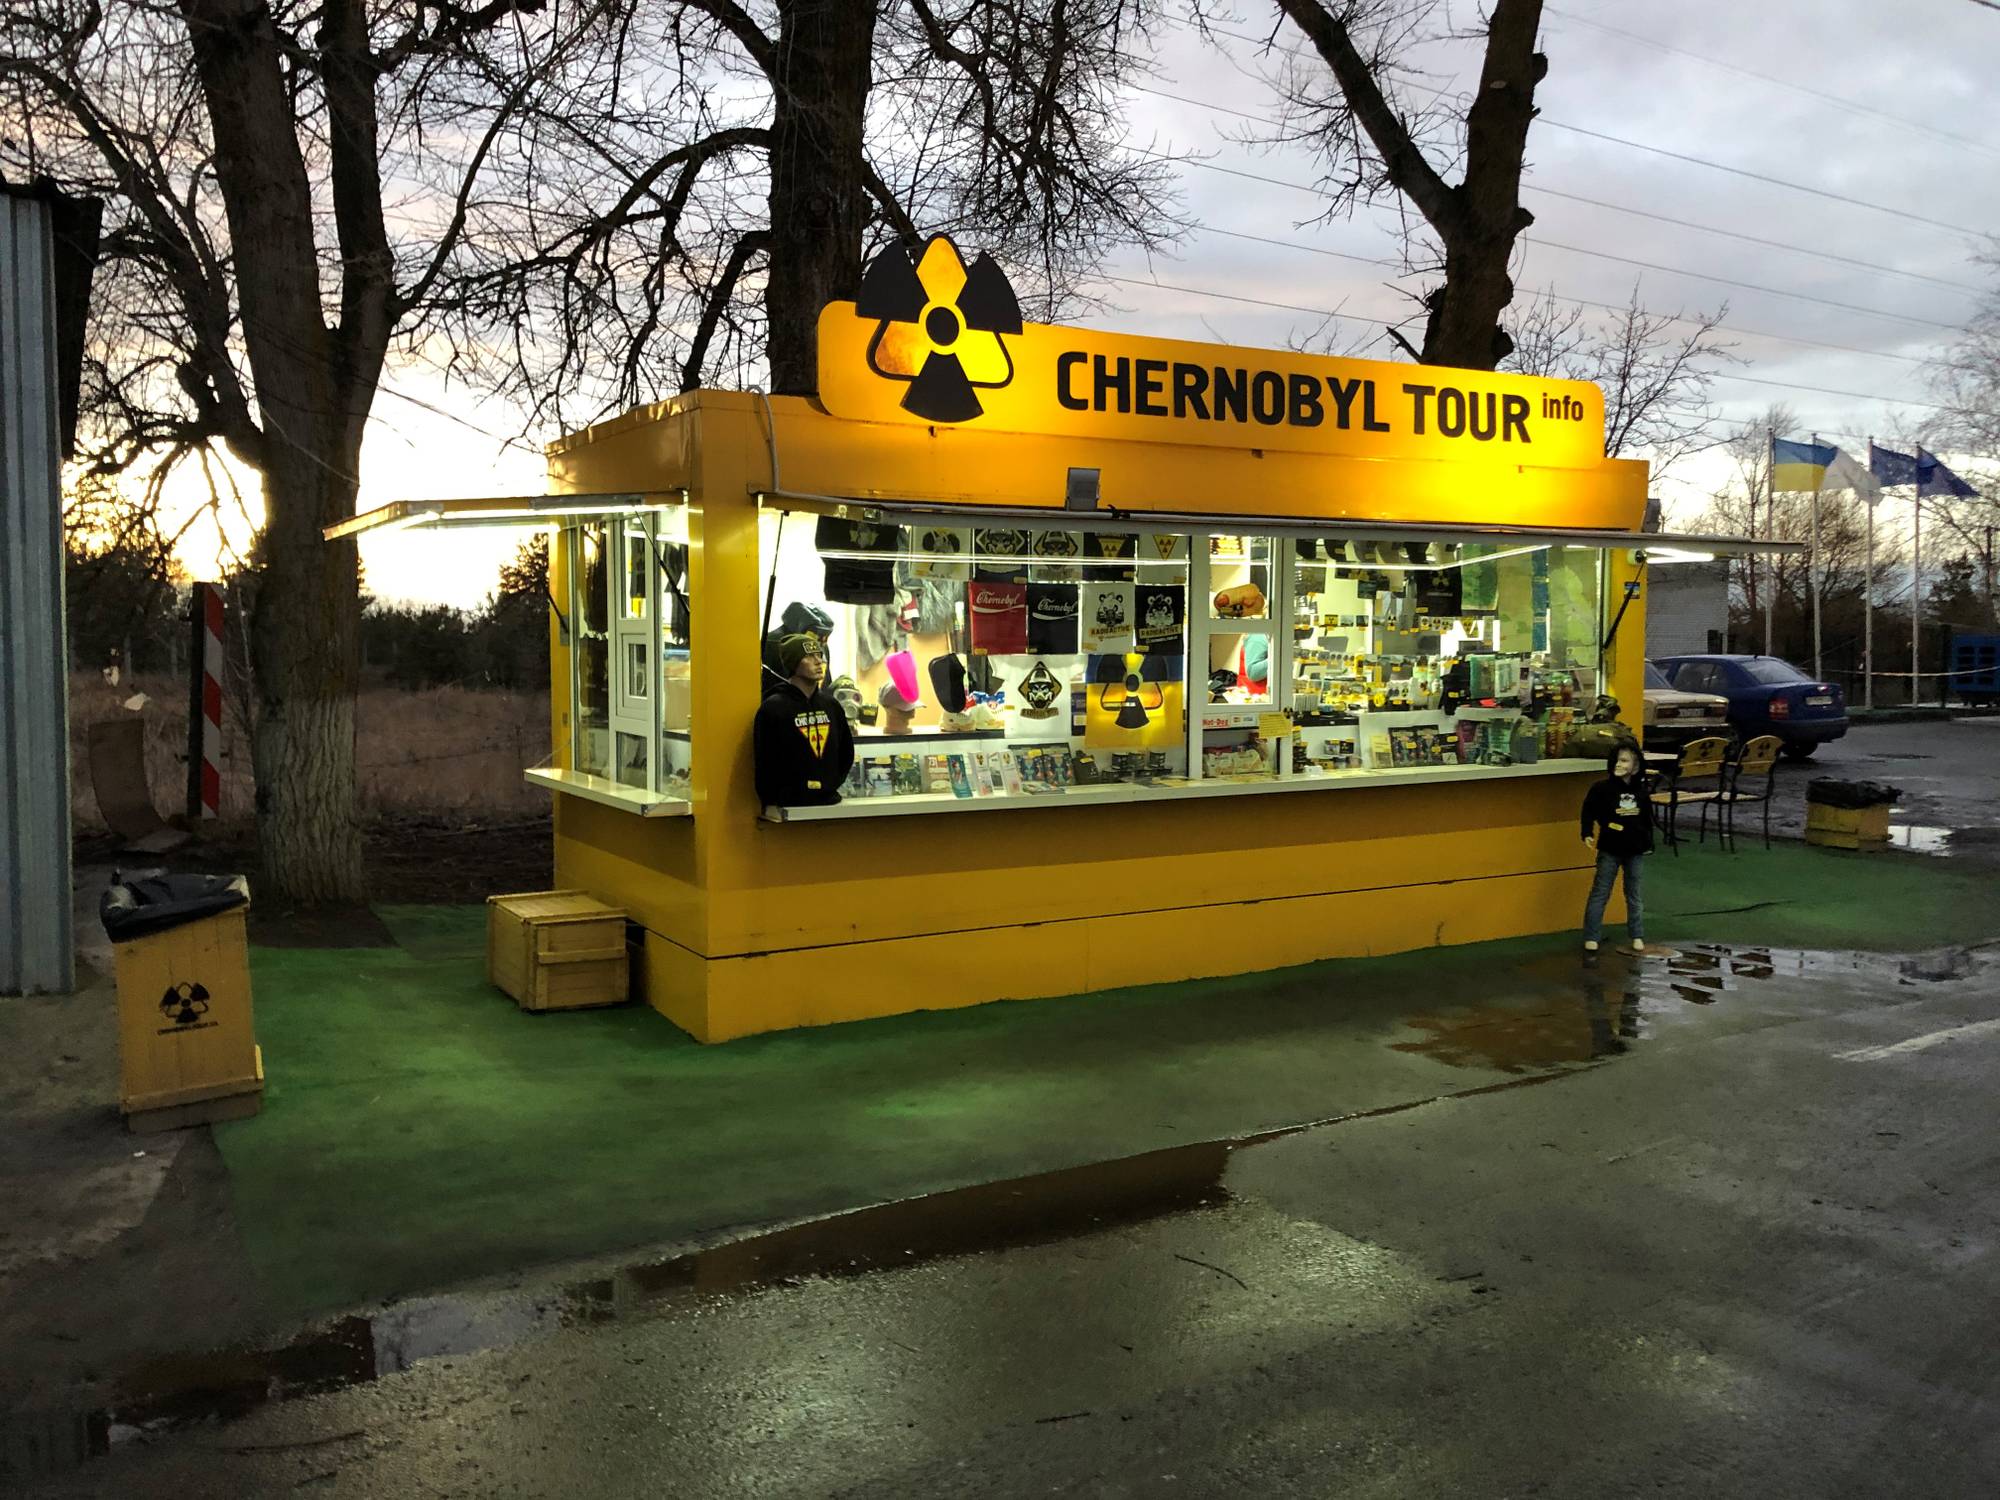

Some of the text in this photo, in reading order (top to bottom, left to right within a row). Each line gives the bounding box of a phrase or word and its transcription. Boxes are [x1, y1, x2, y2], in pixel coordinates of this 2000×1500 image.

[1057, 351, 1584, 443] CHERNOBYL TOUR info
